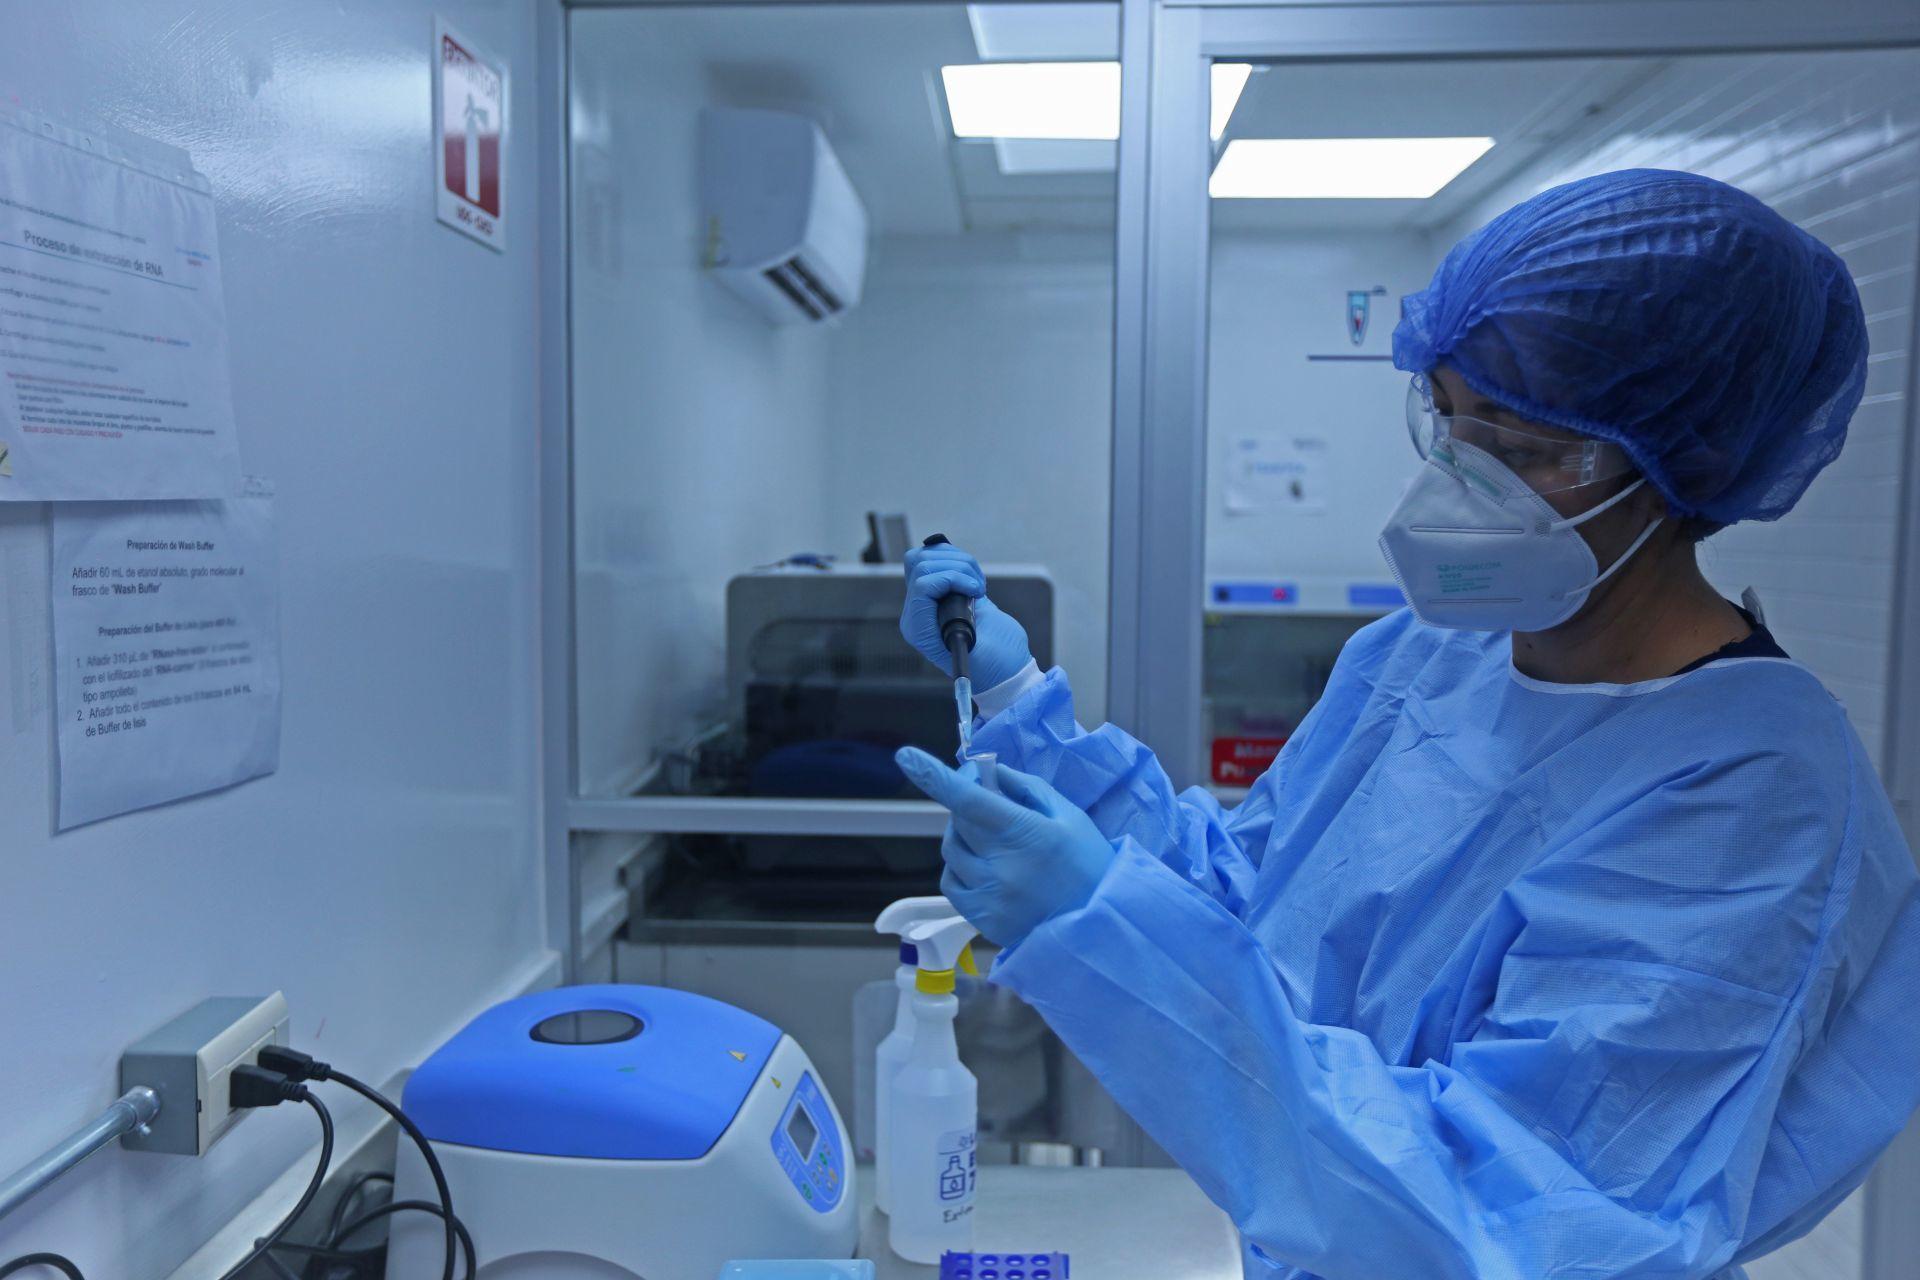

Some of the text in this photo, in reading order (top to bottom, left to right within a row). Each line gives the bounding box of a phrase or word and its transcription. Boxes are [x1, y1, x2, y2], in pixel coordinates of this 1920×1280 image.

[24, 230, 67, 253] Proceso
[133, 258, 144, 271] de
[145, 260, 164, 277] RNA
[127, 539, 215, 552] Preparación de Wash Buffer
[72, 567, 98, 579] Añadir
[112, 567, 124, 578] mL
[126, 567, 136, 578] de
[72, 585, 97, 597] frasco
[99, 585, 110, 596] de
[98, 625, 142, 639] Preparación
[143, 623, 154, 634] del
[86, 654, 111, 668] Añadir
[82, 673, 97, 685] con
[98, 672, 106, 684] el
[83, 691, 98, 703] tipo
[89, 706, 114, 720] Añadir
[115, 703, 132, 715] todo
[85, 726, 97, 738] de
[98, 720, 121, 736] Buffer
[122, 718, 132, 731] de
